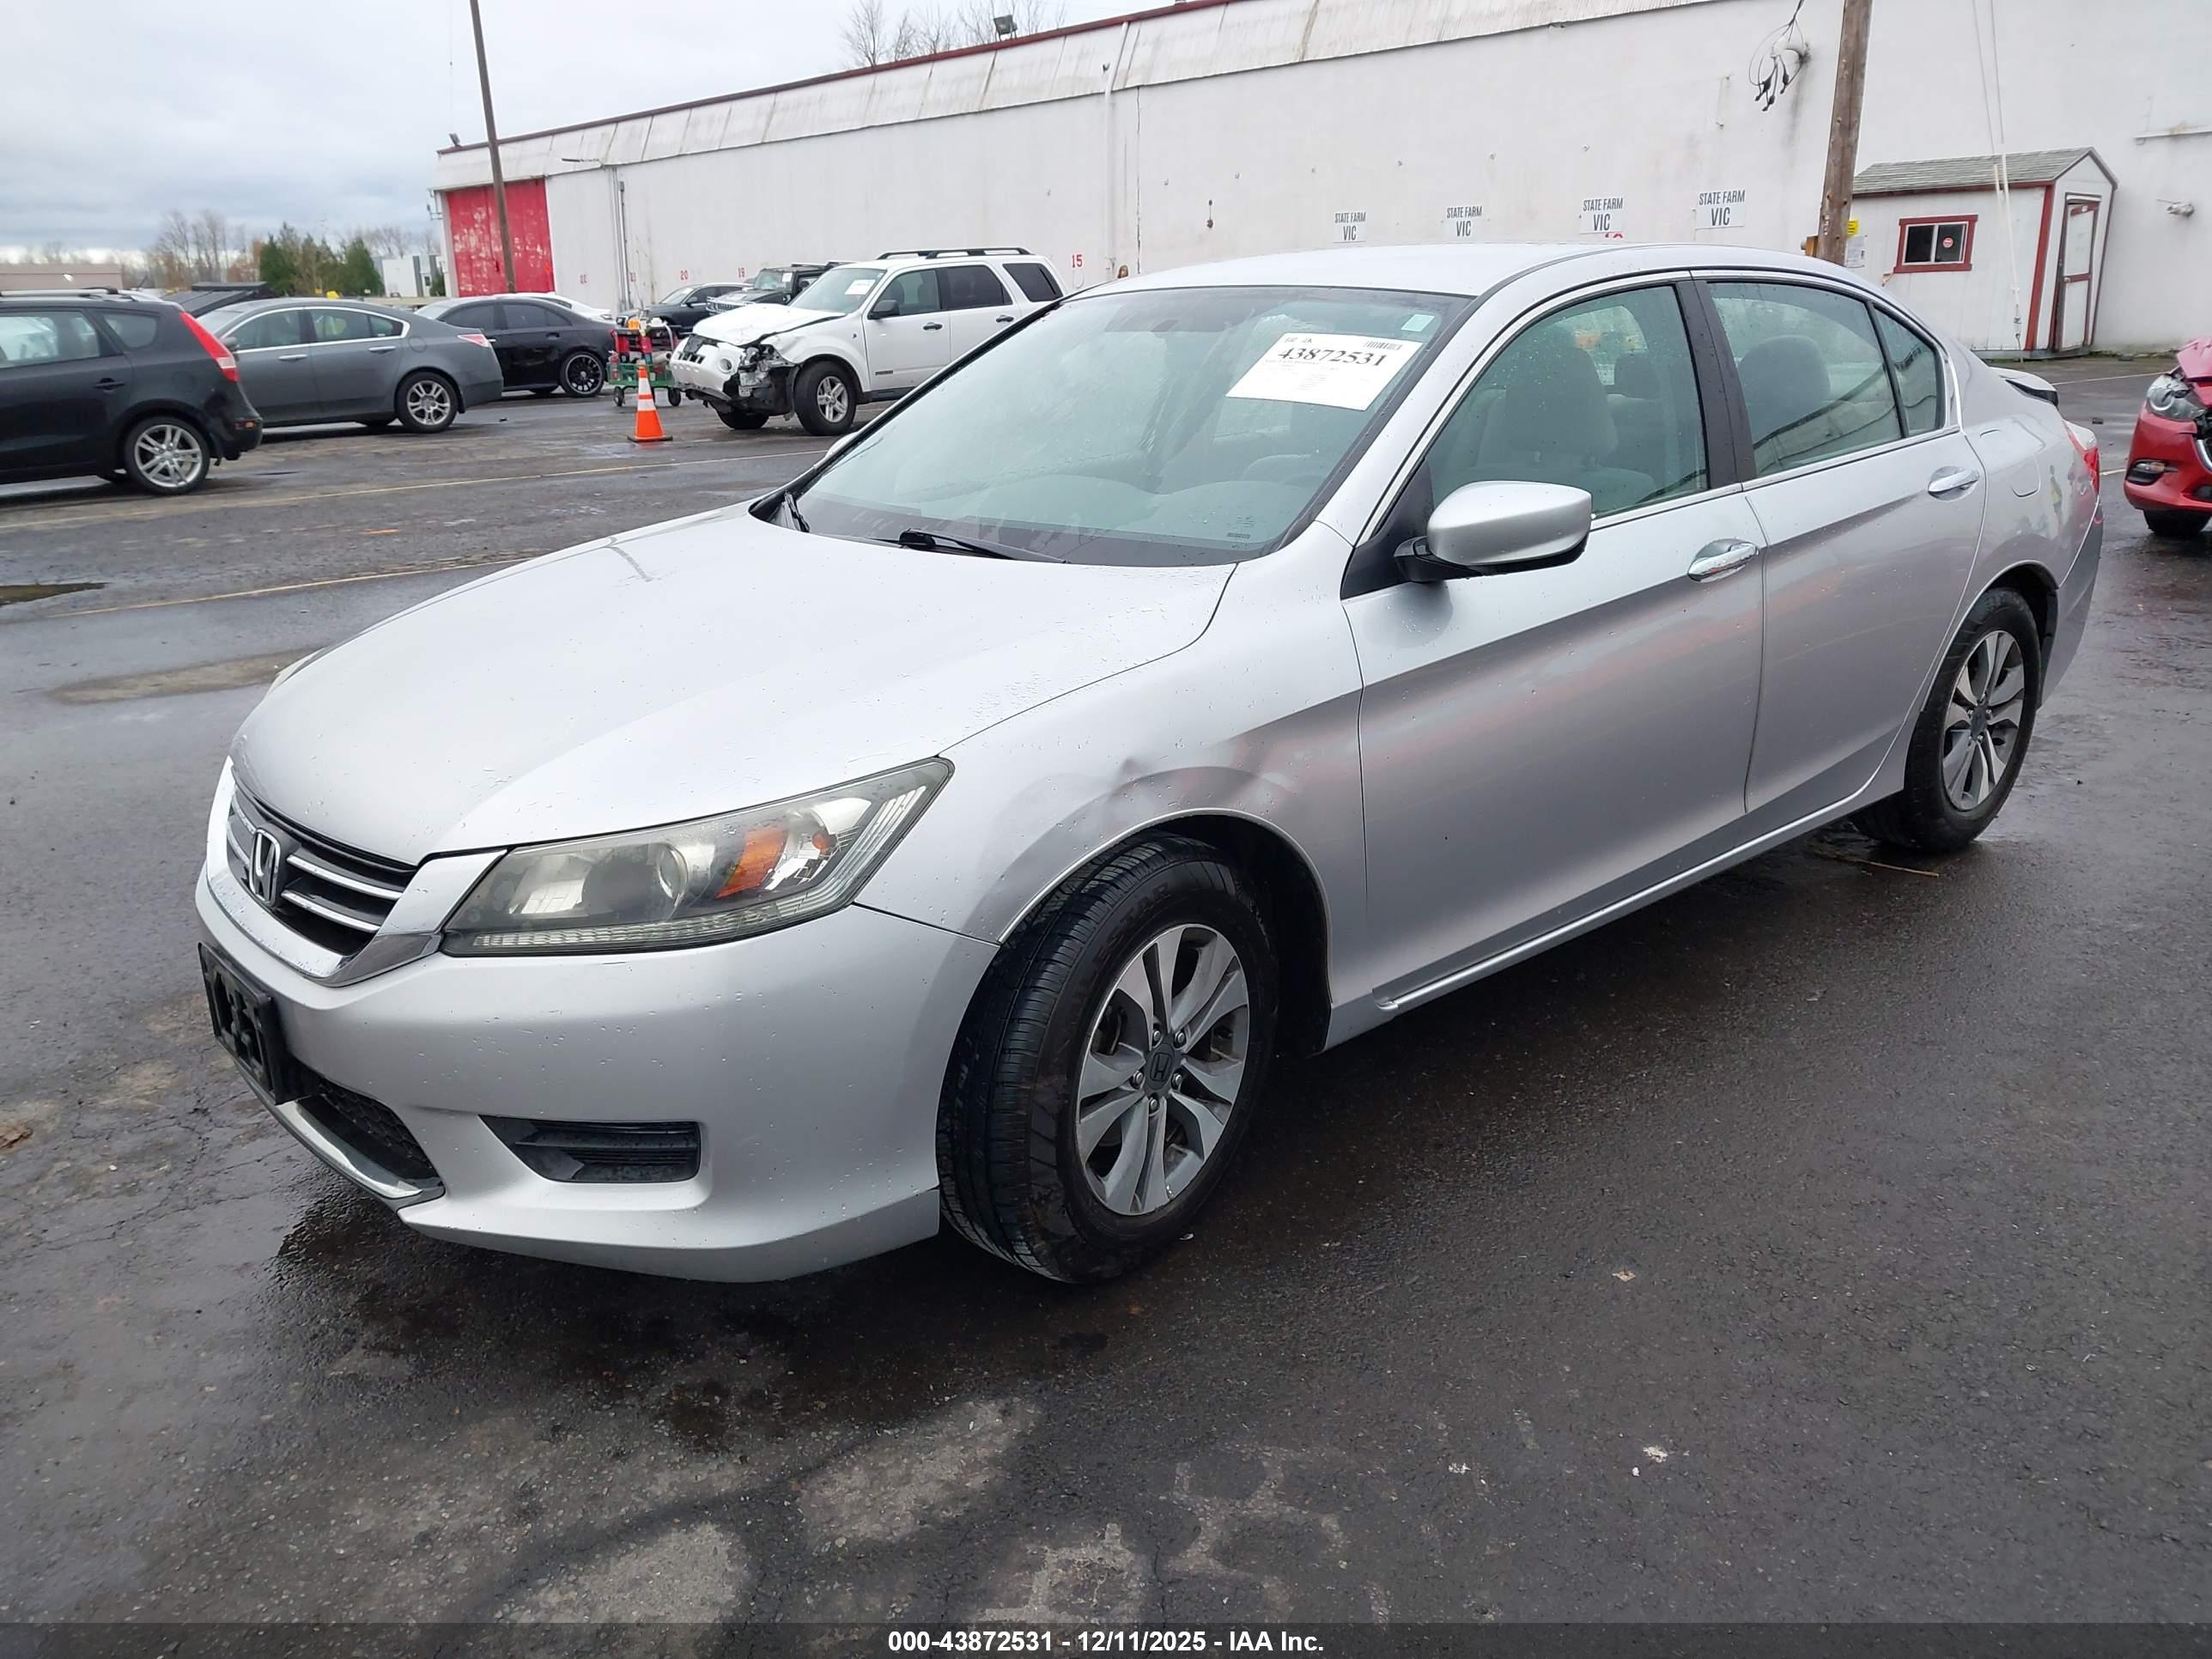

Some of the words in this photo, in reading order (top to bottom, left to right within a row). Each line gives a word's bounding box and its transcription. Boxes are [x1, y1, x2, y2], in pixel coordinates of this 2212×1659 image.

[1583, 198, 1601, 211] STATE
[1603, 198, 1623, 210] FARM
[1698, 191, 1721, 205] STATE
[1723, 190, 1746, 203] FARM
[1334, 213, 1349, 223] STATE
[1350, 211, 1366, 222] FARM
[1446, 207, 1463, 218] STATE
[1464, 205, 1482, 217] FARM
[1711, 207, 1730, 226] VIC
[1455, 220, 1471, 237] VIC
[1593, 214, 1611, 231] VIC
[1343, 225, 1357, 241] VIC
[1072, 253, 1083, 268] 15
[1277, 347, 1388, 366] 43872531
